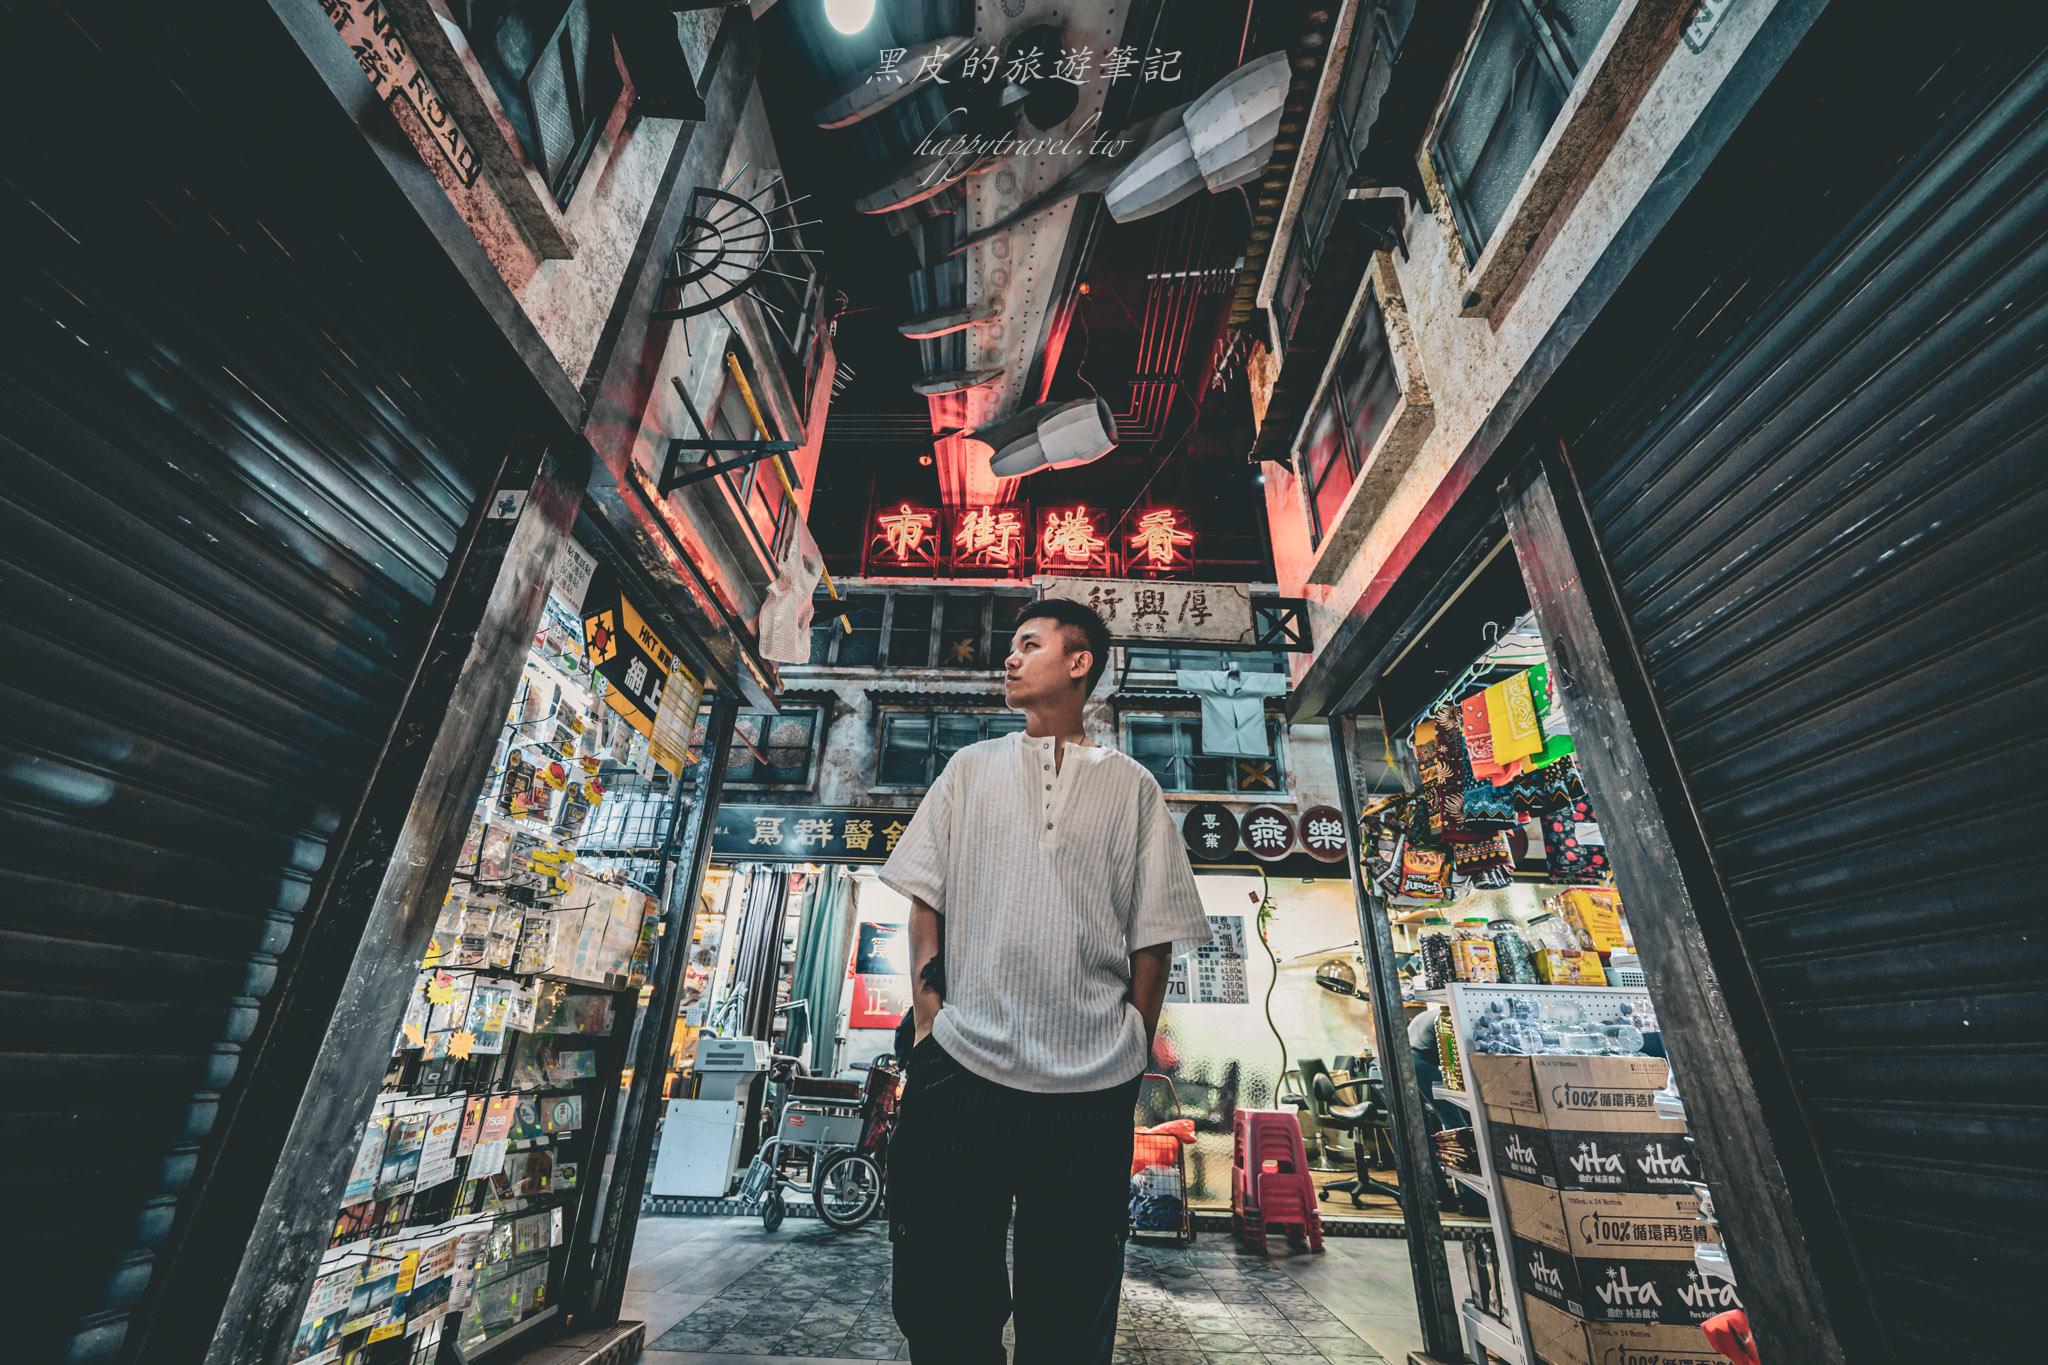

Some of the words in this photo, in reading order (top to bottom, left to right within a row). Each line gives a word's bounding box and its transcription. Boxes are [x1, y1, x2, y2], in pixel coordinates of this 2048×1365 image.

[357, 0, 405, 65] NG
[408, 71, 477, 173] ROAD
[639, 625, 659, 652] HKT
[1564, 1090, 1598, 1108] 100%
[1505, 1134, 1538, 1167] vita
[1569, 1141, 1626, 1175] vita
[1637, 1143, 1691, 1176] vita
[1593, 1220, 1631, 1242] 100%
[1528, 1250, 1564, 1291] vita
[1595, 1265, 1662, 1307] vita
[1677, 1268, 1743, 1308] vita
